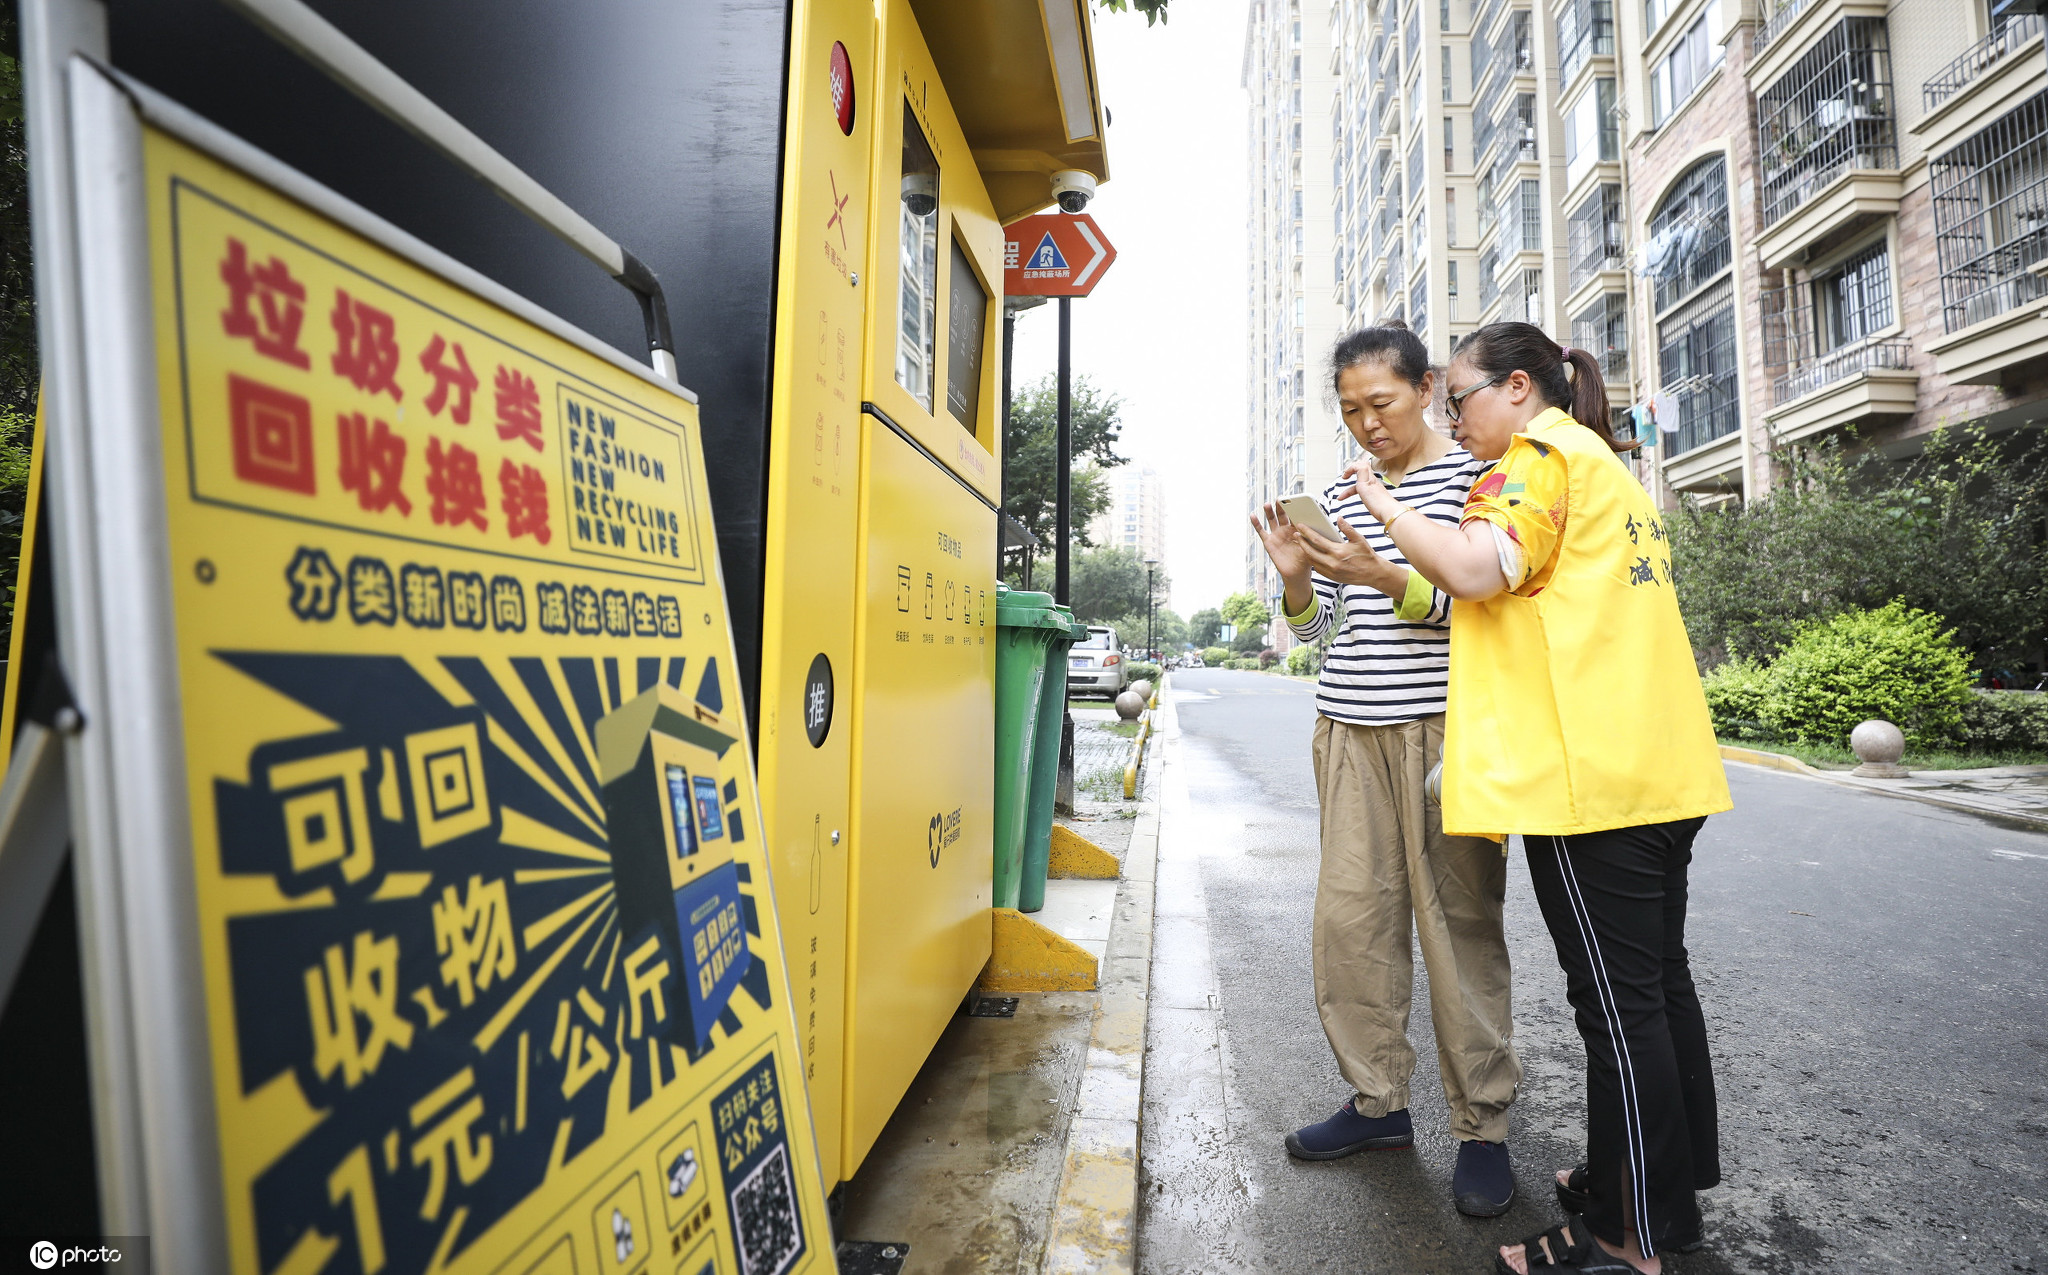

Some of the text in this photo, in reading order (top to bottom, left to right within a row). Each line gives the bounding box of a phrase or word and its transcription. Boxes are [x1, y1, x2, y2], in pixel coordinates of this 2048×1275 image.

[219, 234, 546, 453] 垃圾分类
[567, 398, 615, 440] NEW
[226, 371, 552, 547] 回收换钱
[569, 427, 666, 483] FASHION
[571, 455, 615, 492] NEW
[574, 485, 679, 534] RECYCLING
[576, 514, 680, 558] NEW LIFE
[285, 545, 682, 638] 分类新时尚 减法新生活
[808, 682, 826, 729] 推
[268, 721, 492, 885] 可回
[718, 1068, 774, 1133] 扫码关注
[725, 1096, 778, 1173] 公众号
